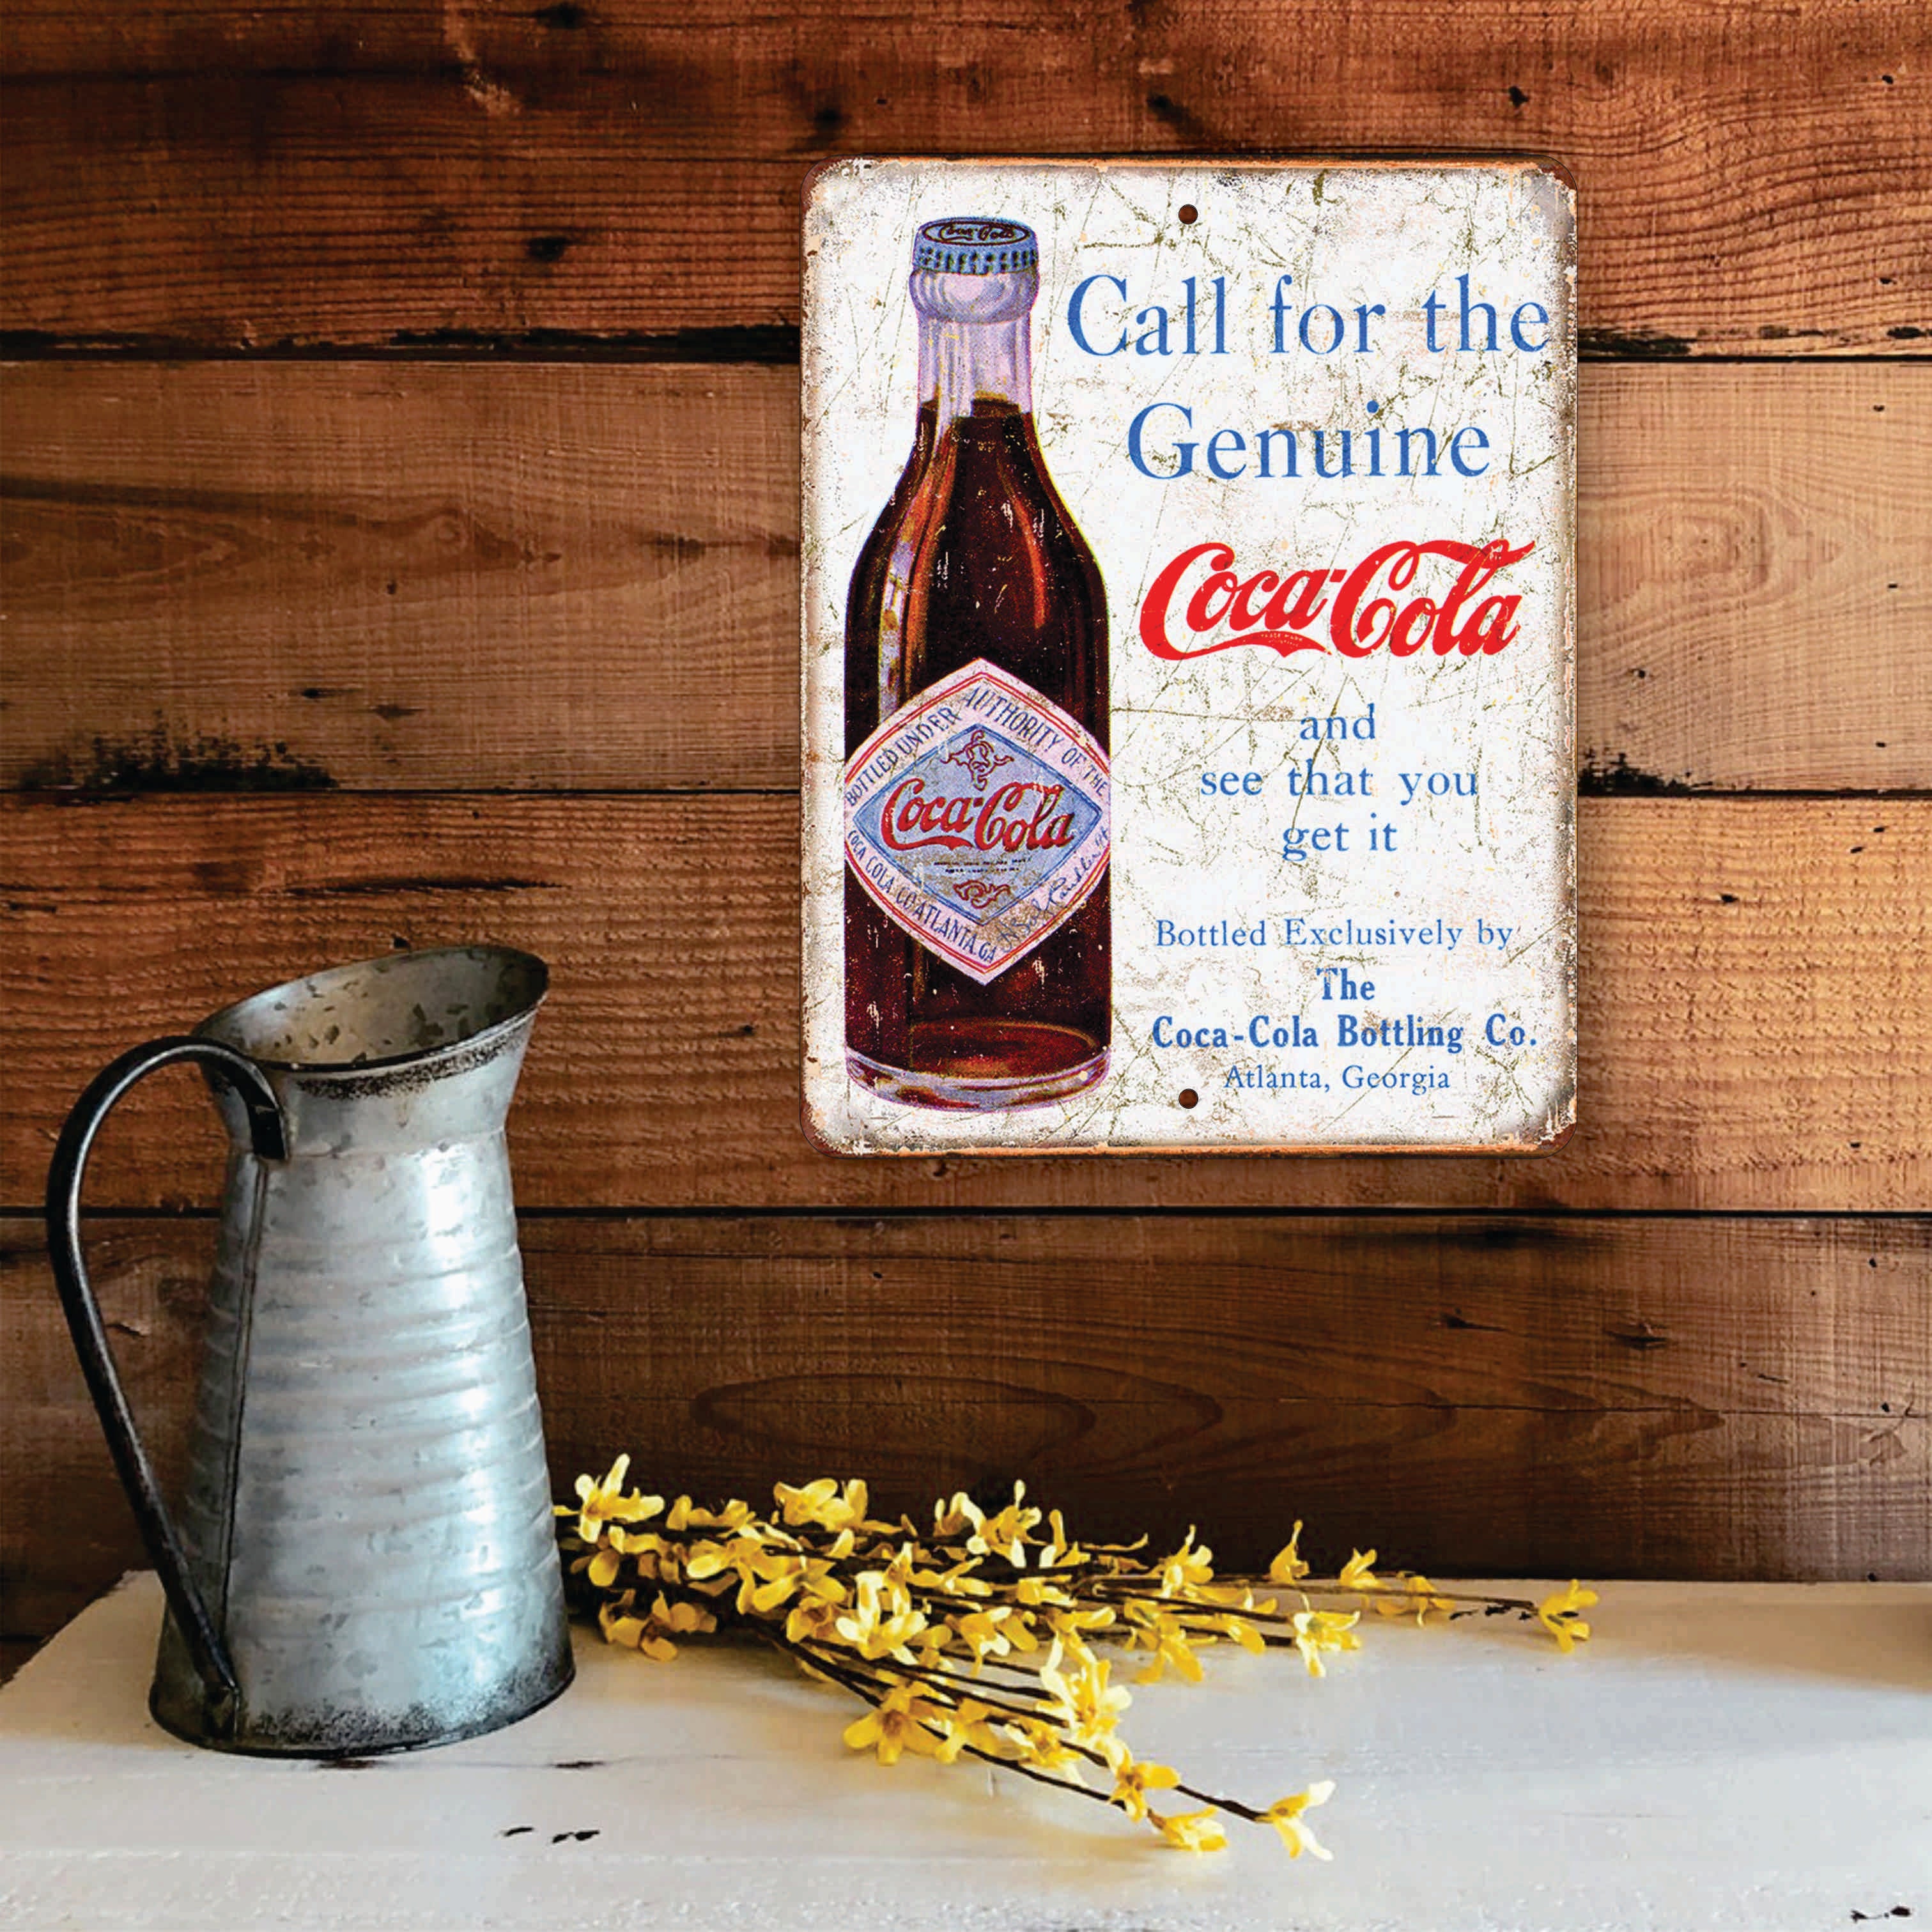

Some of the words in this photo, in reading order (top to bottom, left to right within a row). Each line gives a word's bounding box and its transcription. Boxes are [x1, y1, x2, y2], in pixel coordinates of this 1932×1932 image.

[1067, 274, 1230, 357] Call
[1269, 274, 1386, 355] for
[1421, 273, 1549, 353] the
[1127, 400, 1490, 480] Genuine
[1140, 539, 1535, 661] Coca-Cola
[844, 749, 899, 807] BOTTLED
[895, 707, 962, 755] UNDER
[961, 685, 1065, 752] AUTHORITY
[1061, 746, 1087, 768] OF
[1083, 764, 1108, 797] THE
[1299, 703, 1376, 740] and
[1200, 771, 1263, 796] see
[1287, 758, 1374, 797] that
[1398, 772, 1478, 806] you
[881, 777, 1074, 851] Coca-Cola
[1281, 823, 1350, 862] get
[1369, 812, 1398, 853] it
[847, 830, 867, 861] COCA
[865, 856, 895, 894] COLA
[1155, 919, 1267, 947] Bottled
[1285, 918, 1464, 951] Exclusively
[1477, 918, 1514, 951] by
[1315, 968, 1376, 1001] The
[1152, 1014, 1320, 1049] Coca-Cola
[1337, 1014, 1464, 1055] Bottling
[1485, 1014, 1537, 1047] Co.
[1224, 1064, 1331, 1094] Atlanta,
[1341, 1065, 1451, 1096] Georgia
